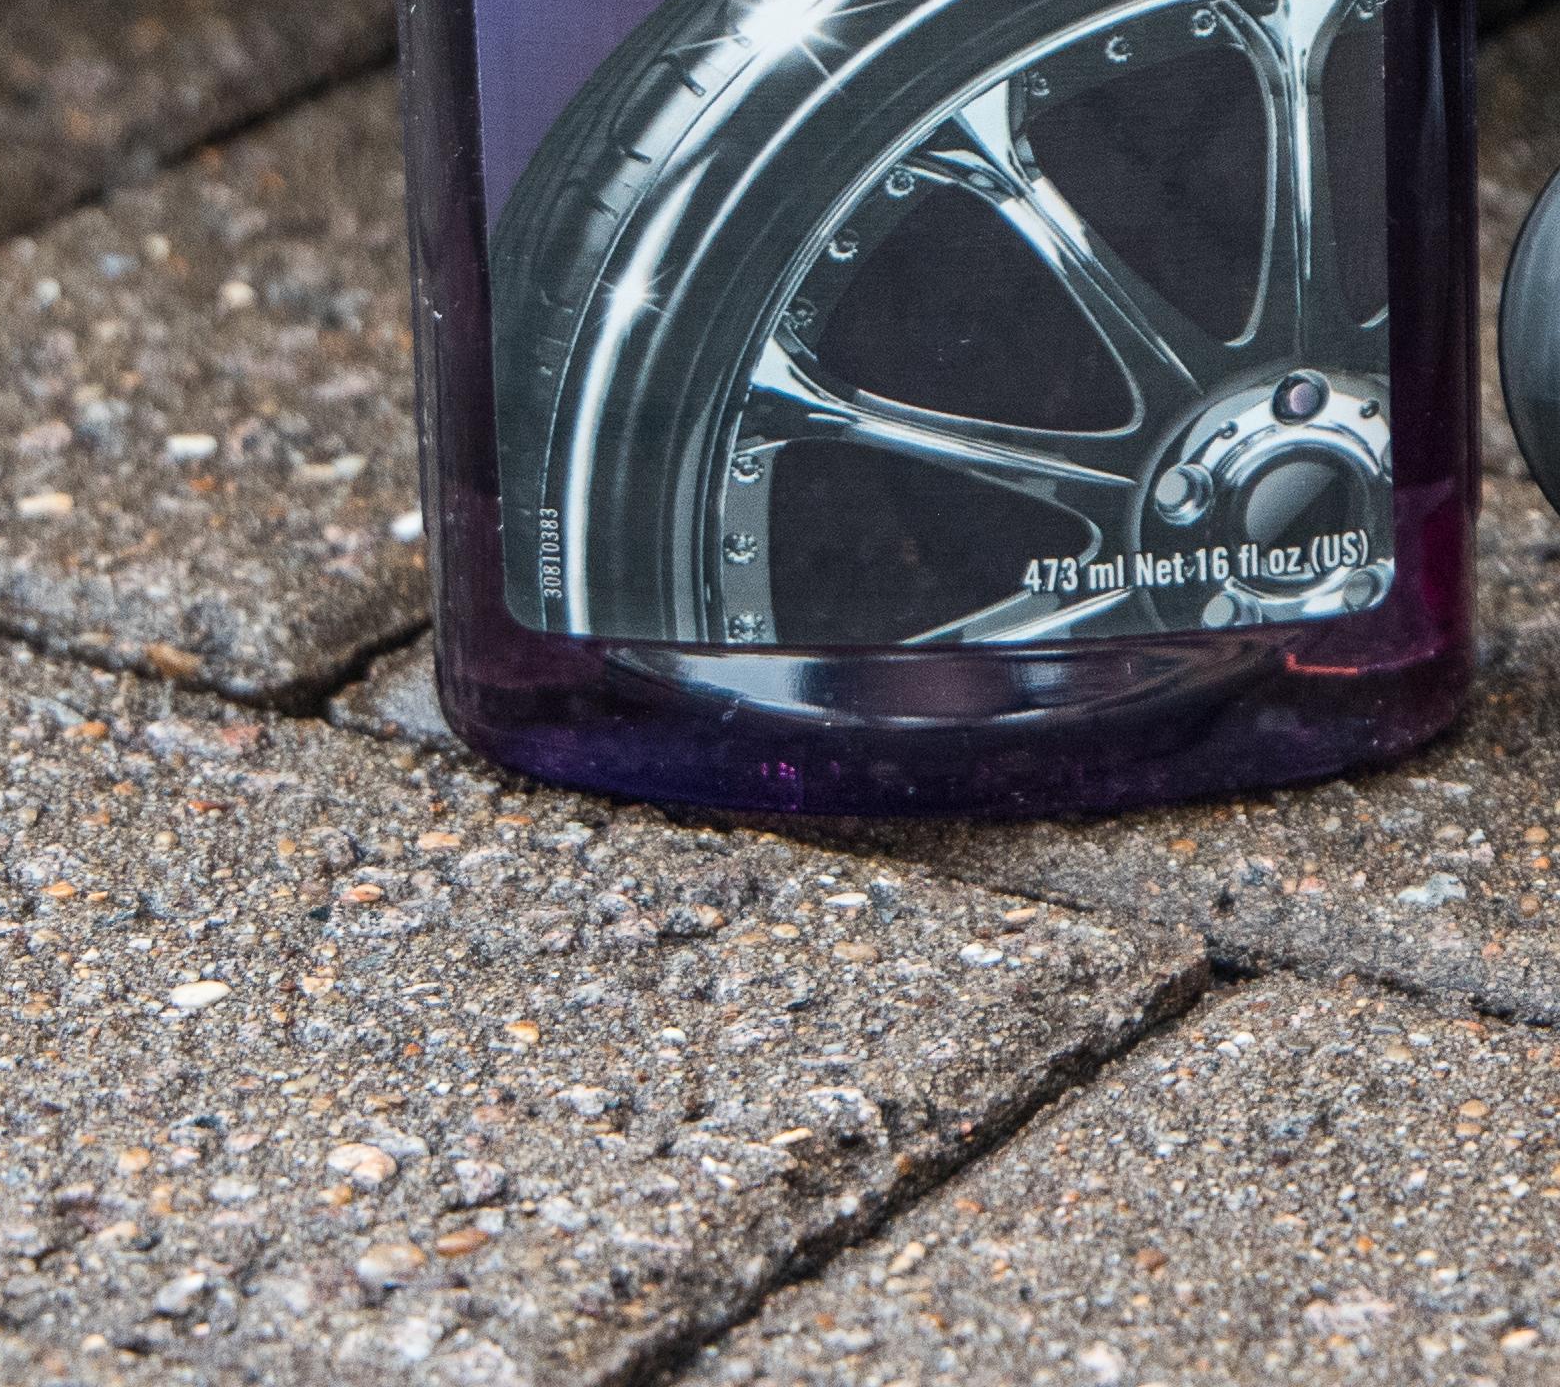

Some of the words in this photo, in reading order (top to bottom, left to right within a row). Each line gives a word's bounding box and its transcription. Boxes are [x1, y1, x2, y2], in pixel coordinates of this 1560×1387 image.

[540, 507, 563, 598] 30810383
[1022, 556, 1080, 595] 473
[1087, 554, 1126, 590] ml
[1134, 549, 1185, 587] Net
[1195, 546, 1229, 582] 16
[1238, 542, 1261, 577] fl
[1267, 544, 1303, 575] oz
[1309, 528, 1370, 573] (US)
